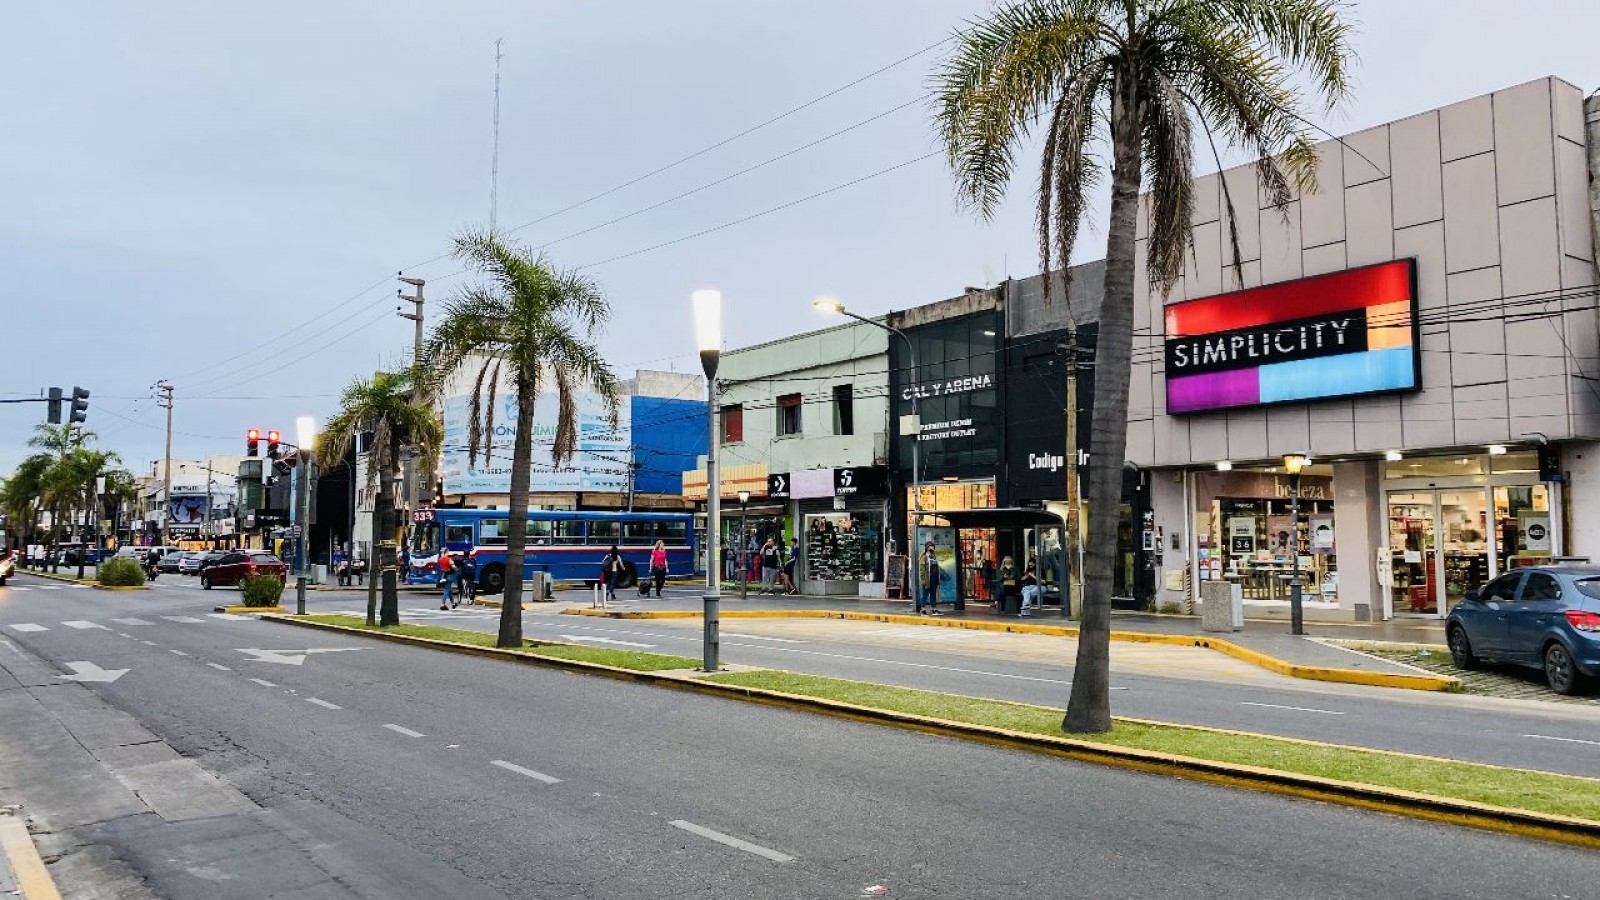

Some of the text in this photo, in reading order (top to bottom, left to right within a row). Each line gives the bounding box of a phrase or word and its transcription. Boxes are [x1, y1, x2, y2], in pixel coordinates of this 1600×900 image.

[1174, 318, 1350, 367] SIMPLICITY
[932, 383, 942, 396] Y
[944, 374, 992, 395] ARENA
